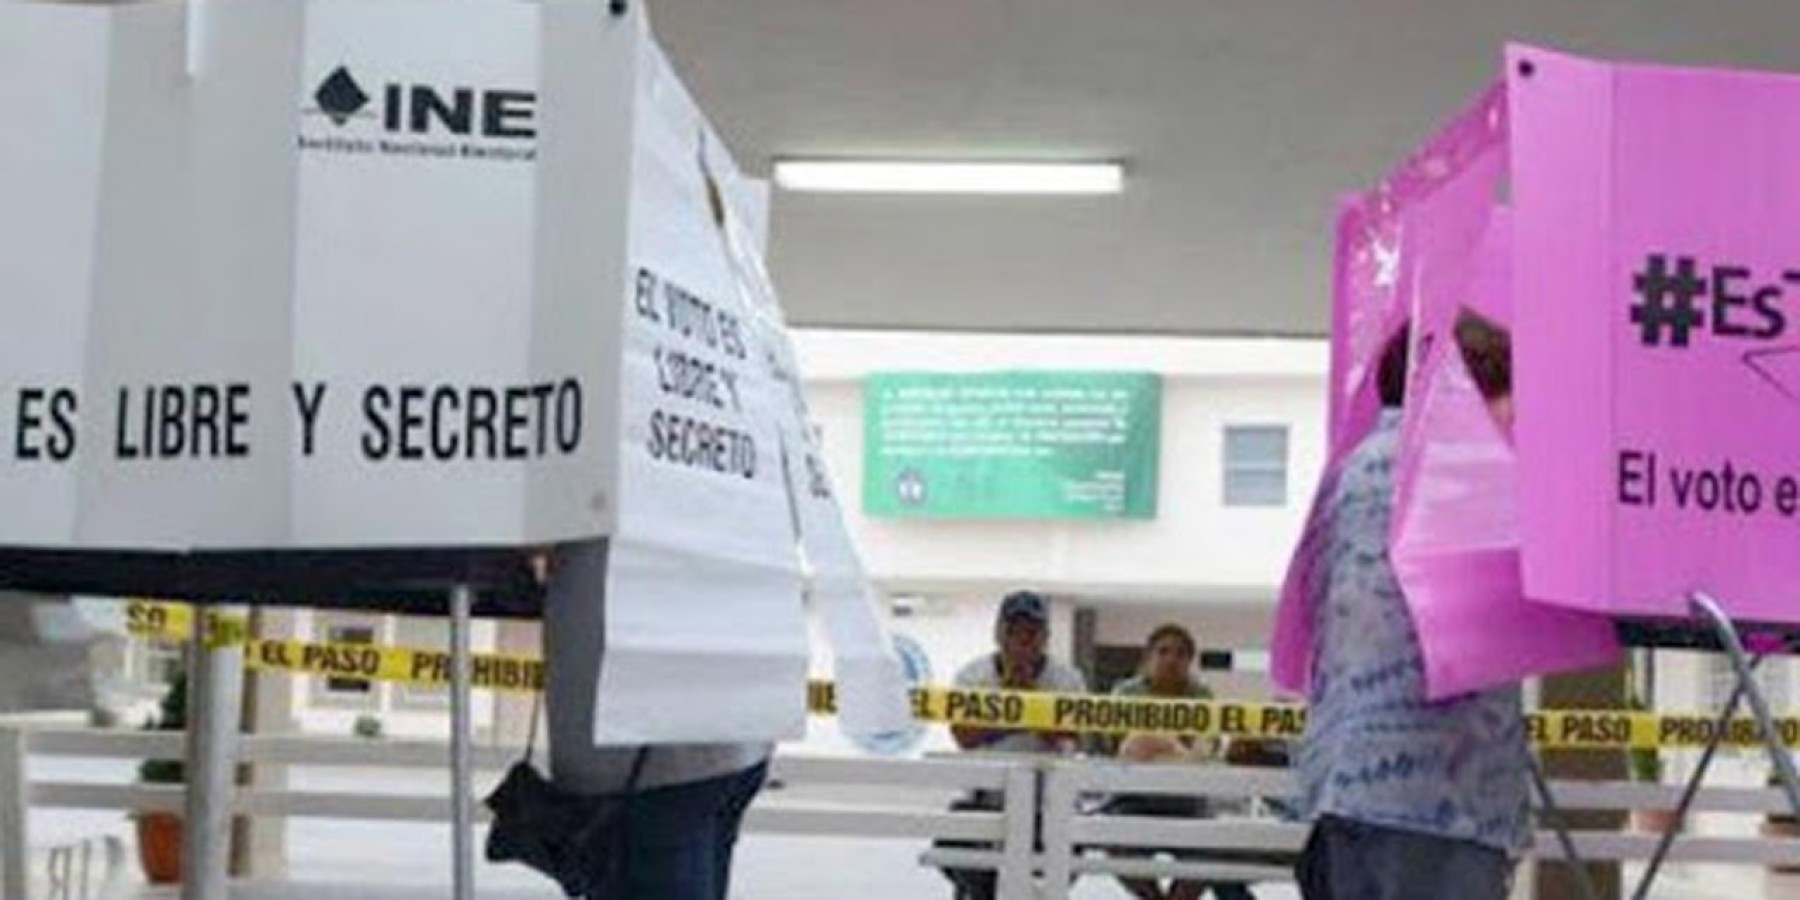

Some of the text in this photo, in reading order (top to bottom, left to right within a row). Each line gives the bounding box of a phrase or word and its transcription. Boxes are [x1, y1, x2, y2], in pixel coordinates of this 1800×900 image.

[384, 83, 537, 138] INE
[635, 266, 661, 323] EL
[716, 308, 747, 360] ES
[719, 367, 742, 413] Y
[14, 377, 583, 461] ES LIBRE Y SECRETO
[647, 408, 757, 480] SECRETO
[1617, 451, 1657, 508] El
[1669, 460, 1763, 515] voto
[261, 638, 291, 667] EL
[301, 642, 382, 677] PASO
[945, 689, 1025, 724] PASO
[1054, 697, 1211, 733] PROHIBIDO
[1219, 704, 1248, 733] EL
[1524, 714, 1549, 741] EL
[1561, 714, 1632, 744] PASO
